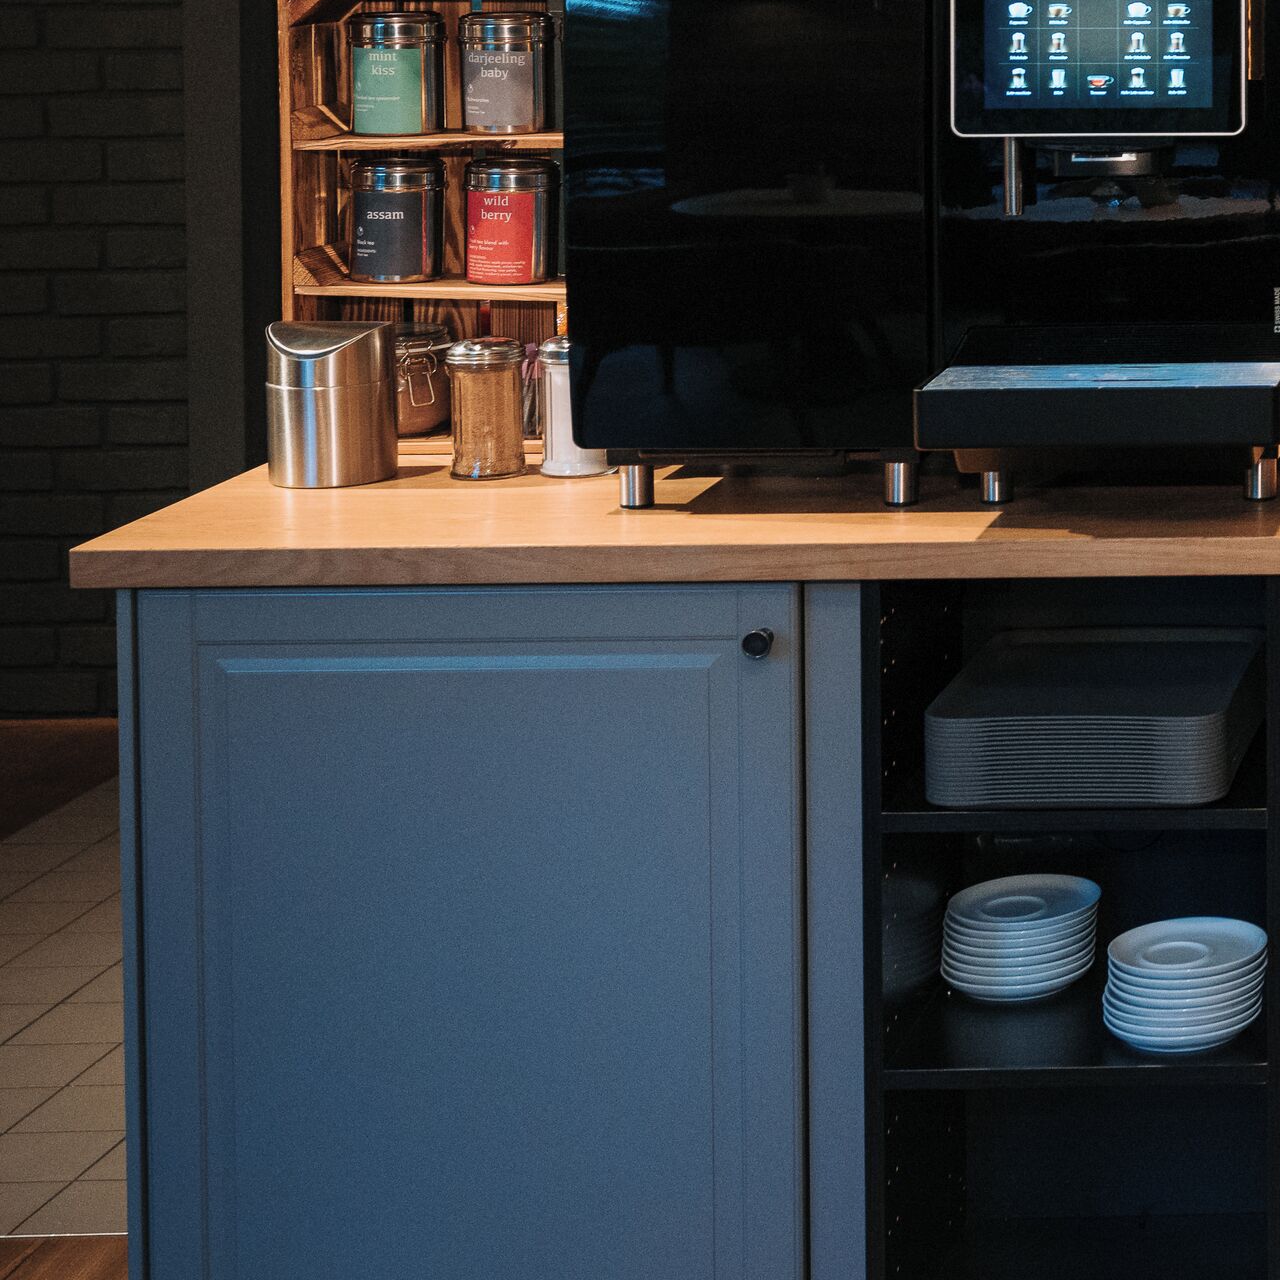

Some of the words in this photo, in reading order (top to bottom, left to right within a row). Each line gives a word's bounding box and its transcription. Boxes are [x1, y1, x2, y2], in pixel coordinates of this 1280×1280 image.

[368, 51, 398, 61] mint
[468, 52, 526, 66] darjeeling
[371, 64, 396, 76] kiss
[481, 66, 509, 80] baby
[483, 195, 509, 207] wild
[366, 211, 404, 220] assam
[481, 208, 512, 223] berry
[1273, 286, 1280, 305] MADE
[1273, 305, 1280, 325] SWISS
